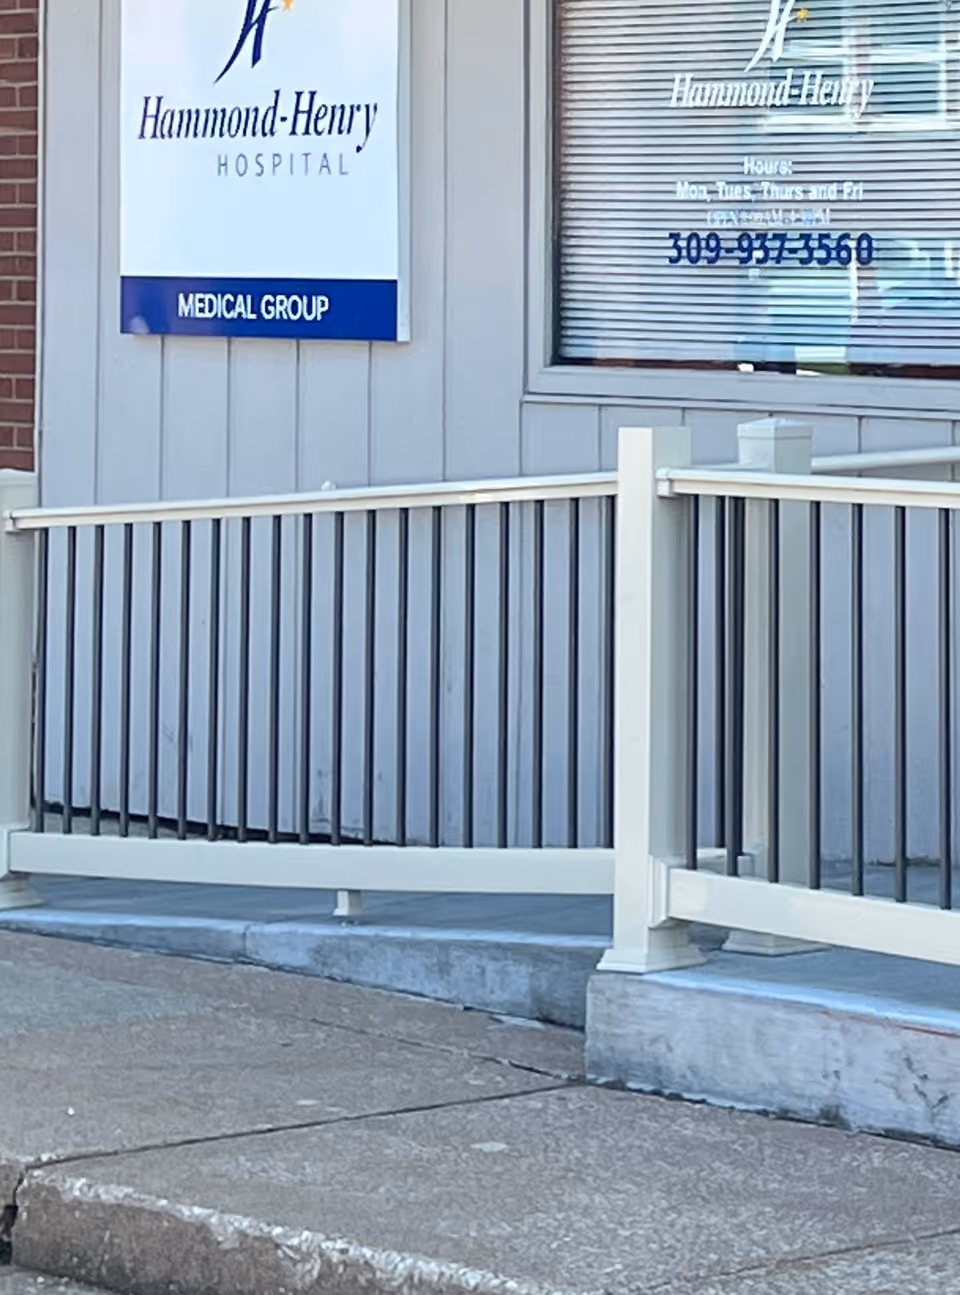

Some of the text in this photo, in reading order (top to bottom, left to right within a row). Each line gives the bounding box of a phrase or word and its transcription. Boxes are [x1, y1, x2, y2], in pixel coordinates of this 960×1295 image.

[669, 68, 875, 120] Hammond-Henry
[137, 88, 379, 154] Hammond-Henry
[216, 152, 350, 178] HOSPITAL
[743, 157, 794, 176] Hours:
[667, 231, 875, 266] 309-937-3560
[177, 292, 330, 322] MEDICAL GROUP
